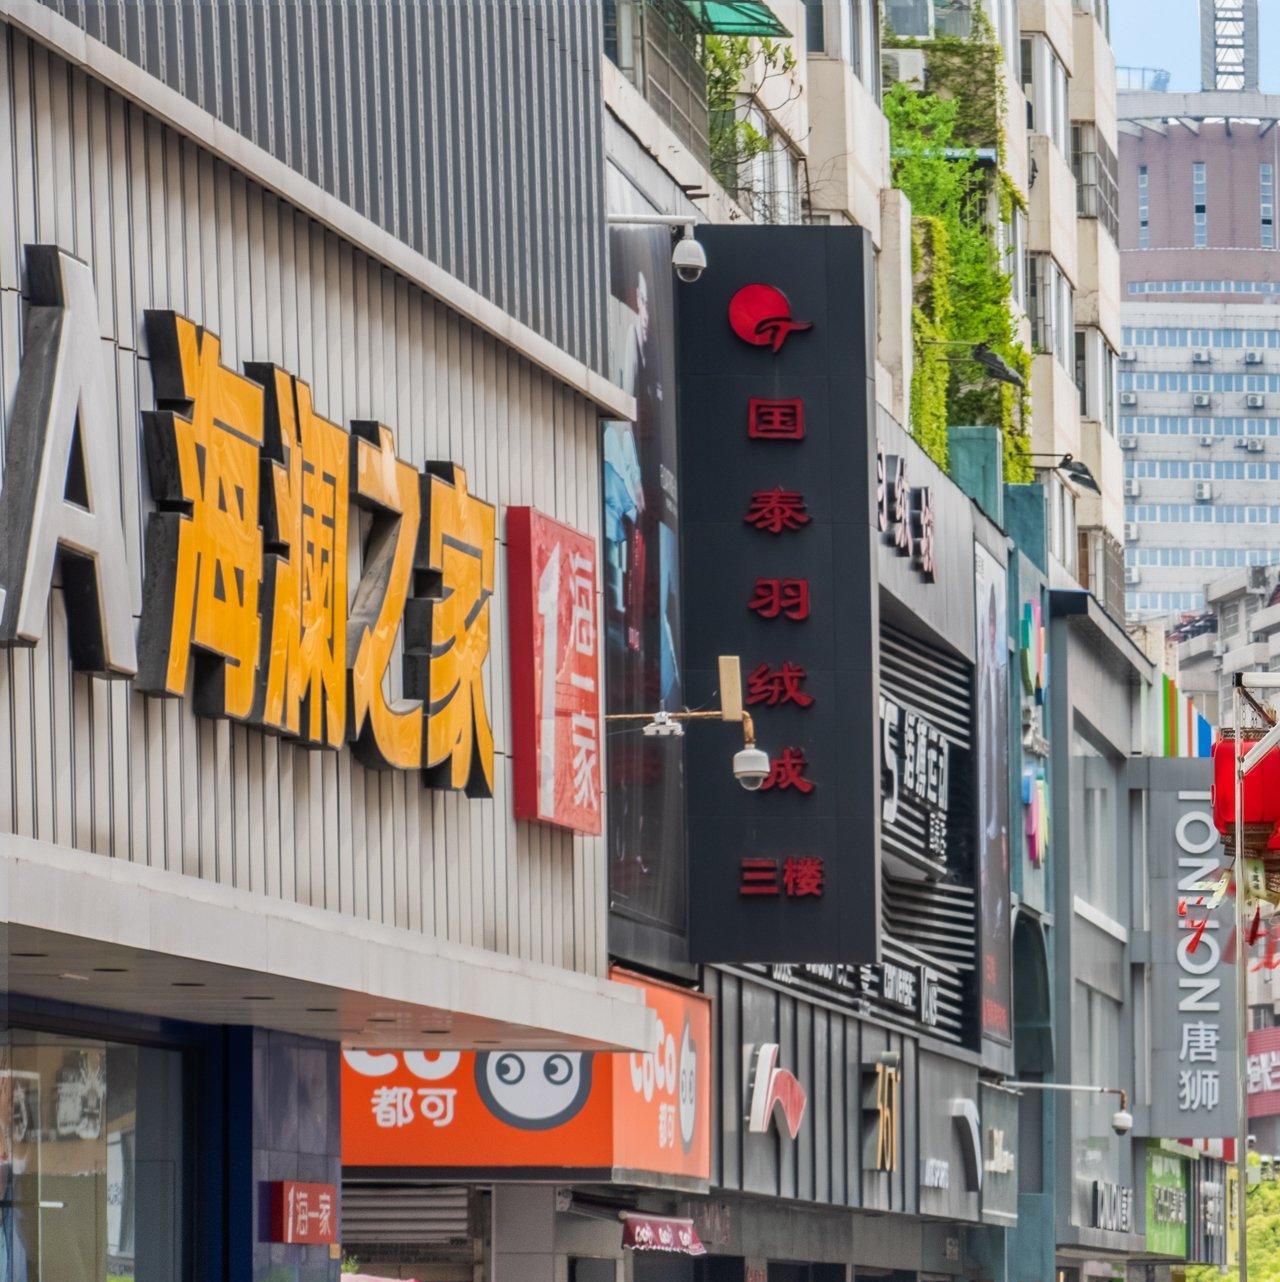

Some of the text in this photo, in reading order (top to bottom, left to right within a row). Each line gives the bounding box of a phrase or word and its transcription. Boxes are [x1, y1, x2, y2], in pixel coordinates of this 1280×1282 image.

[143, 309, 496, 800] 海澜之家
[739, 854, 825, 898] 三楼
[1175, 786, 1222, 1012] TONLION
[1178, 1020, 1222, 1112] 唐狮
[371, 1086, 457, 1128] 都可
[659, 1102, 675, 1149] 都可
